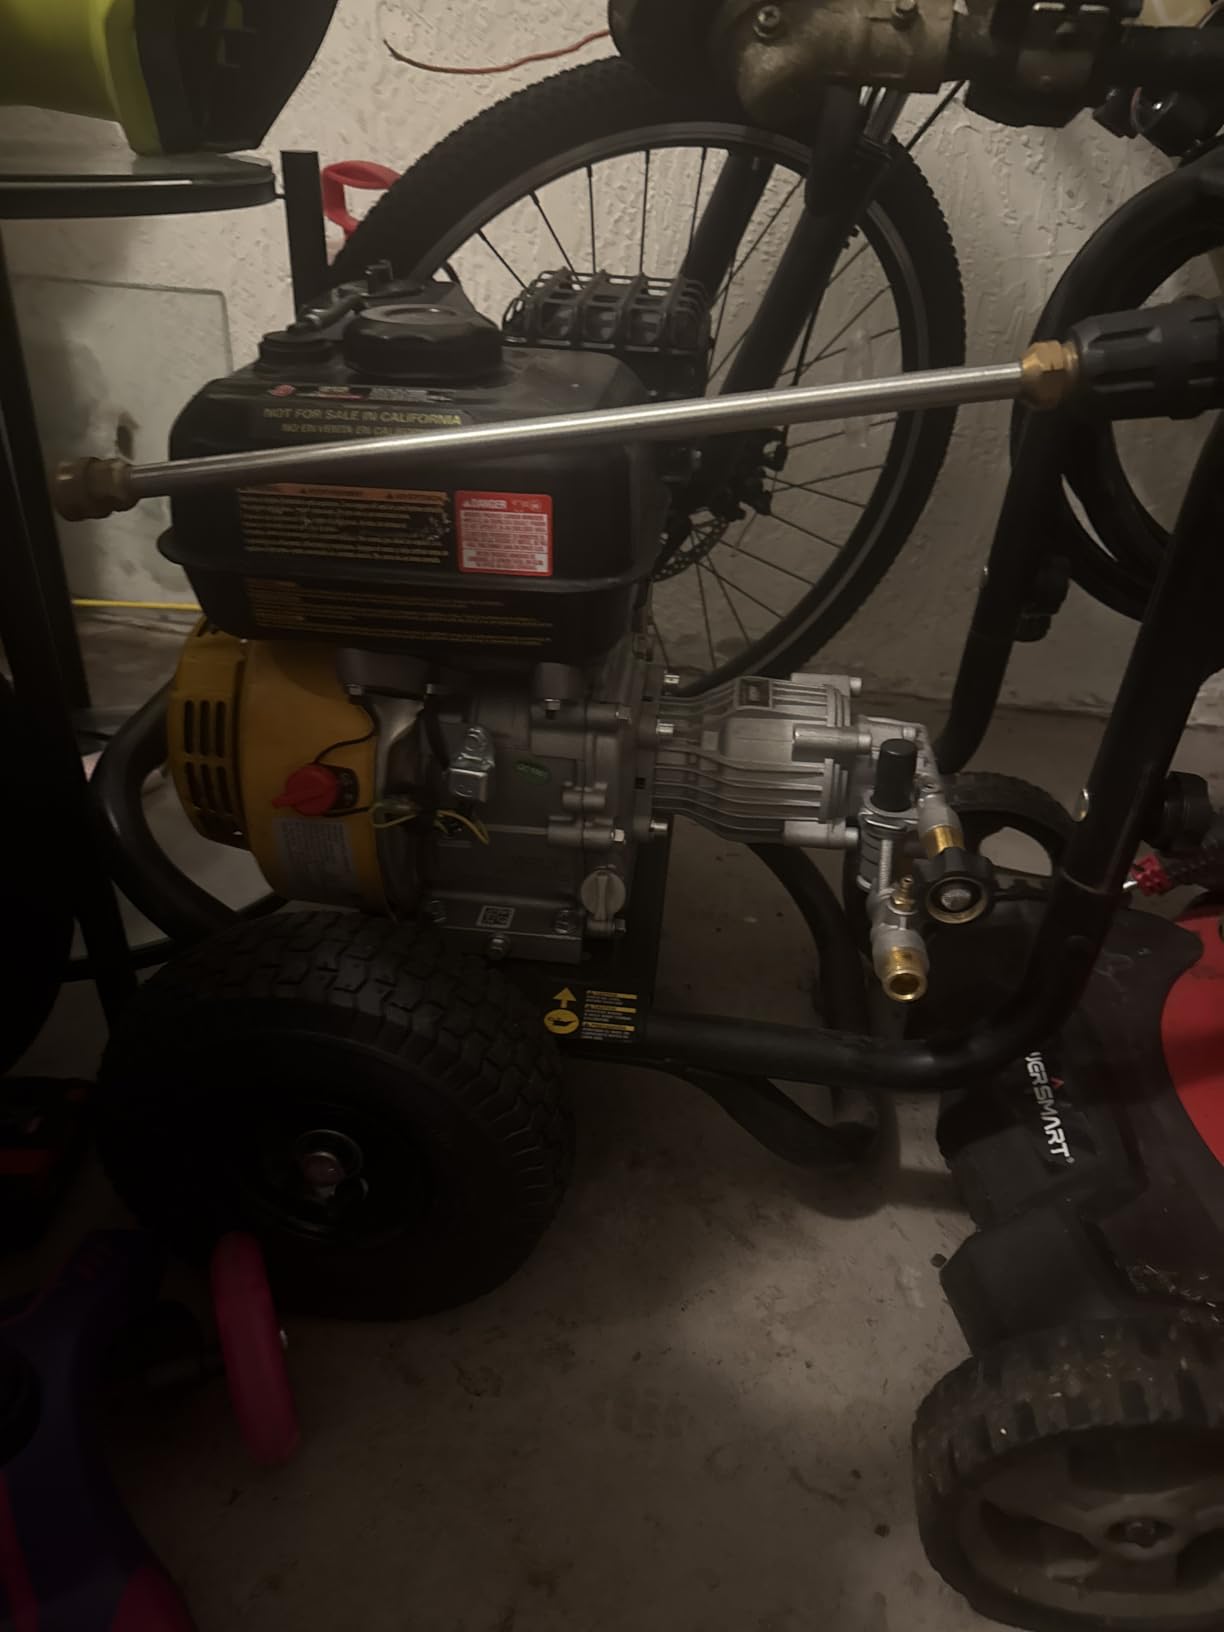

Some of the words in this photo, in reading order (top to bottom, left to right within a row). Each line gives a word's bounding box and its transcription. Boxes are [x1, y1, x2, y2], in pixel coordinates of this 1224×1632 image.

[264, 408, 293, 418] NOT
[295, 408, 321, 419] FOR
[326, 409, 359, 420] SALE
[362, 410, 378, 421] IN
[379, 411, 462, 425] CALIFORNIA
